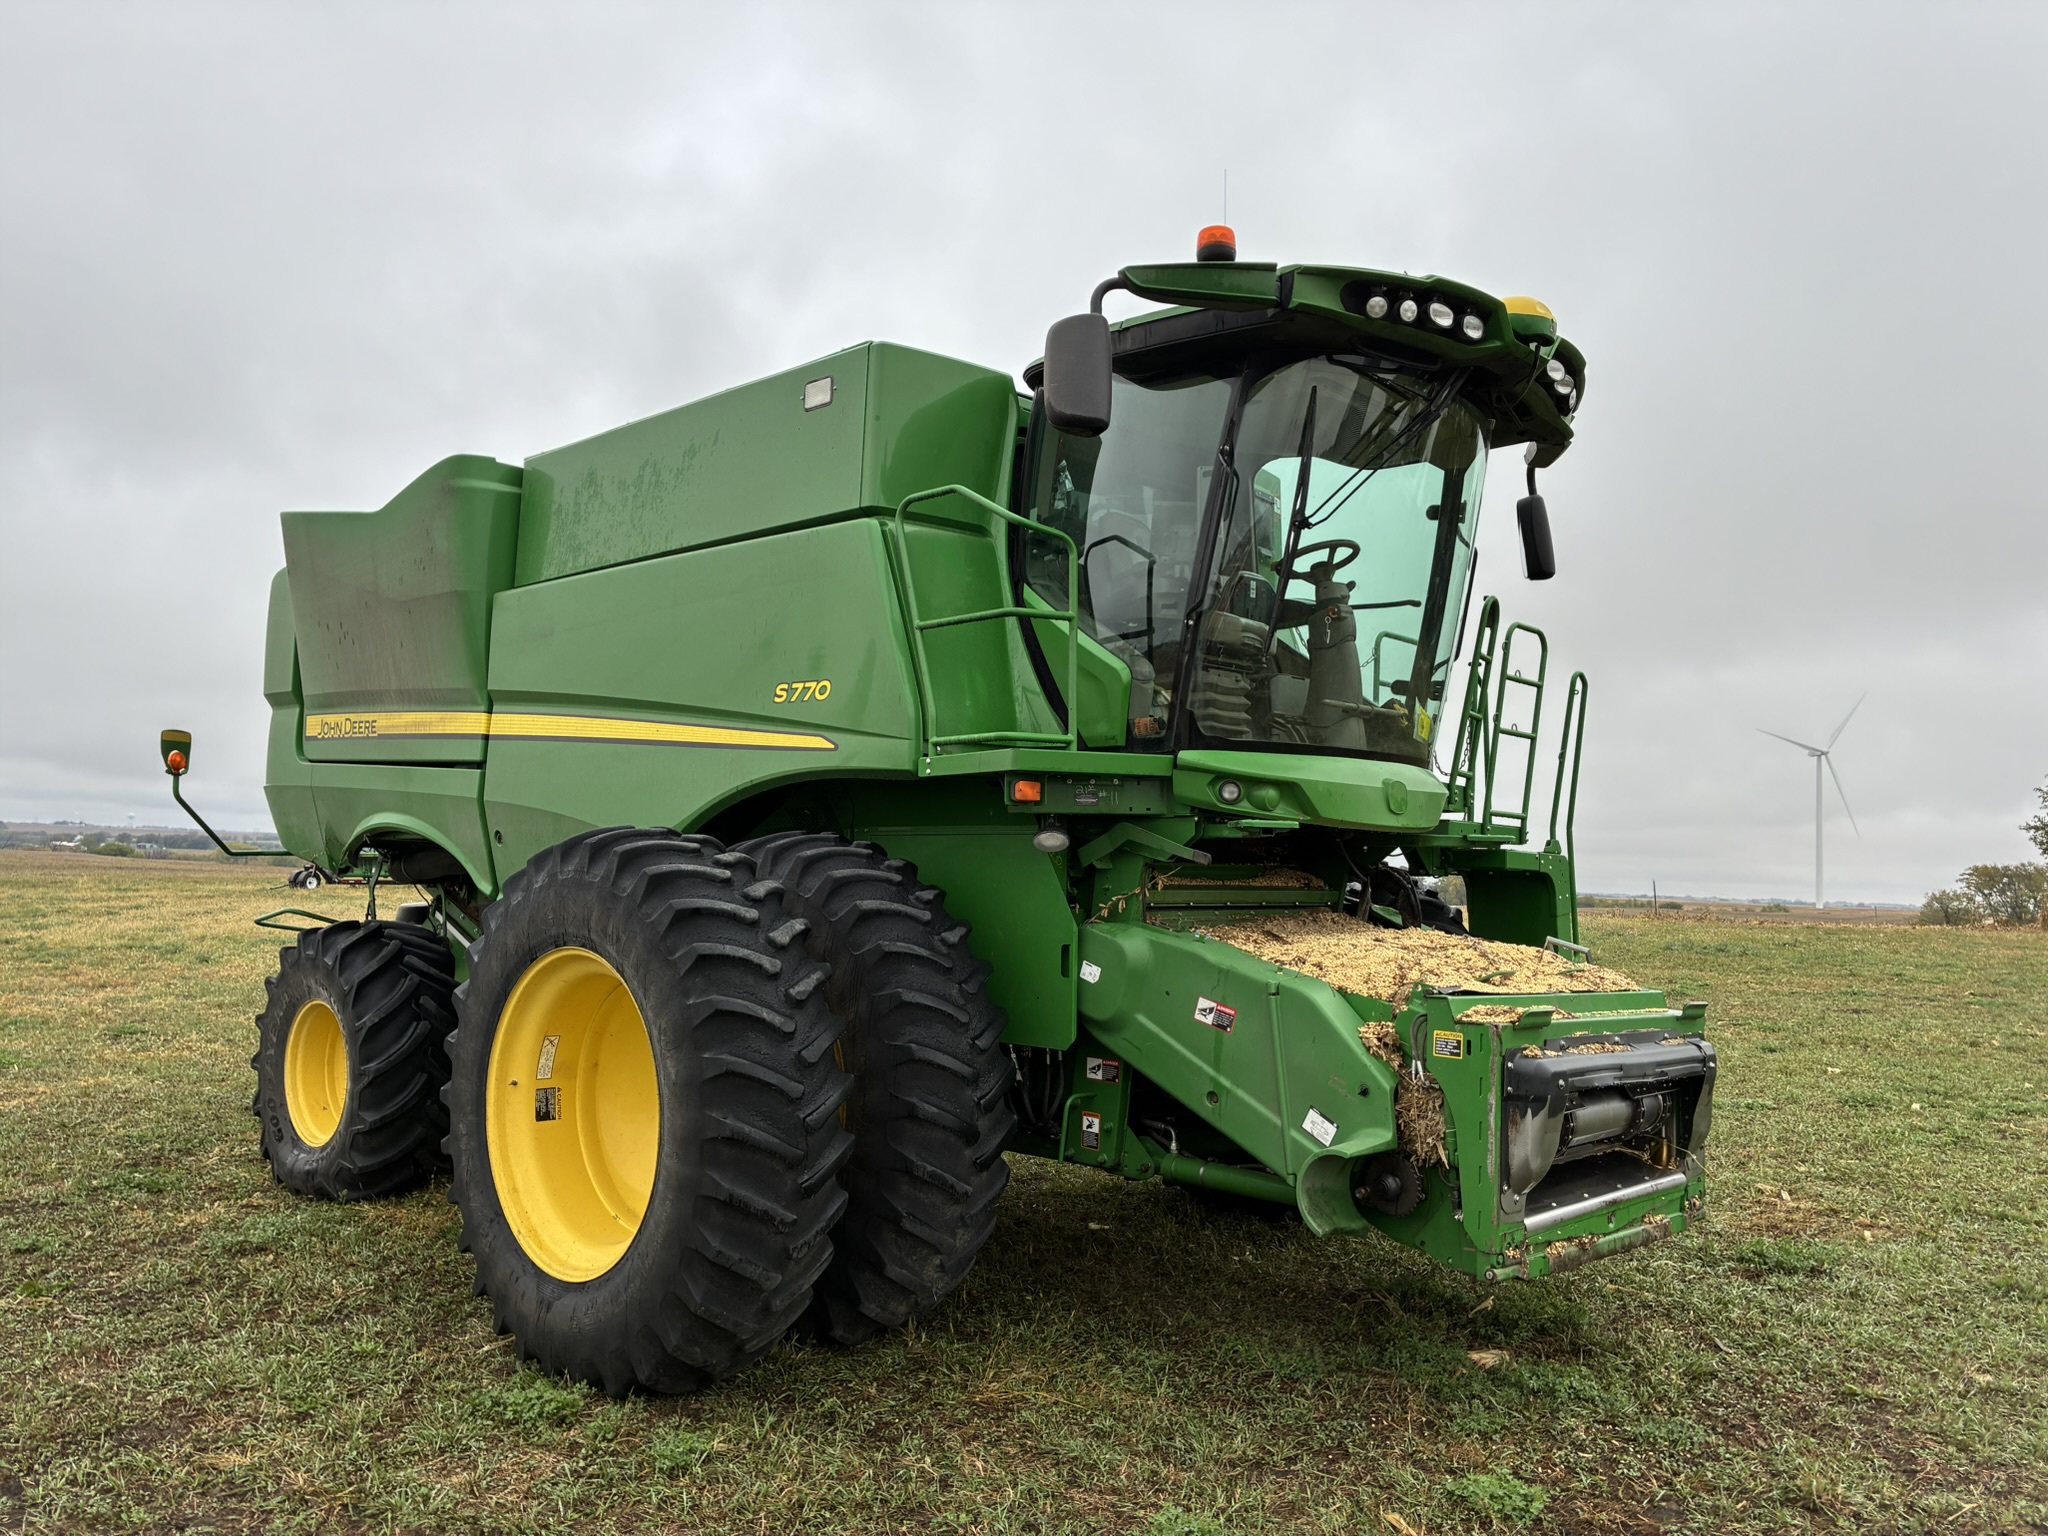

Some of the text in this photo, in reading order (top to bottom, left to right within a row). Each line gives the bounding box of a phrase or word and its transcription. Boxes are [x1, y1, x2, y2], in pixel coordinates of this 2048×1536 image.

[773, 679, 832, 704] S770
[317, 718, 378, 738] JOHN DEERE
